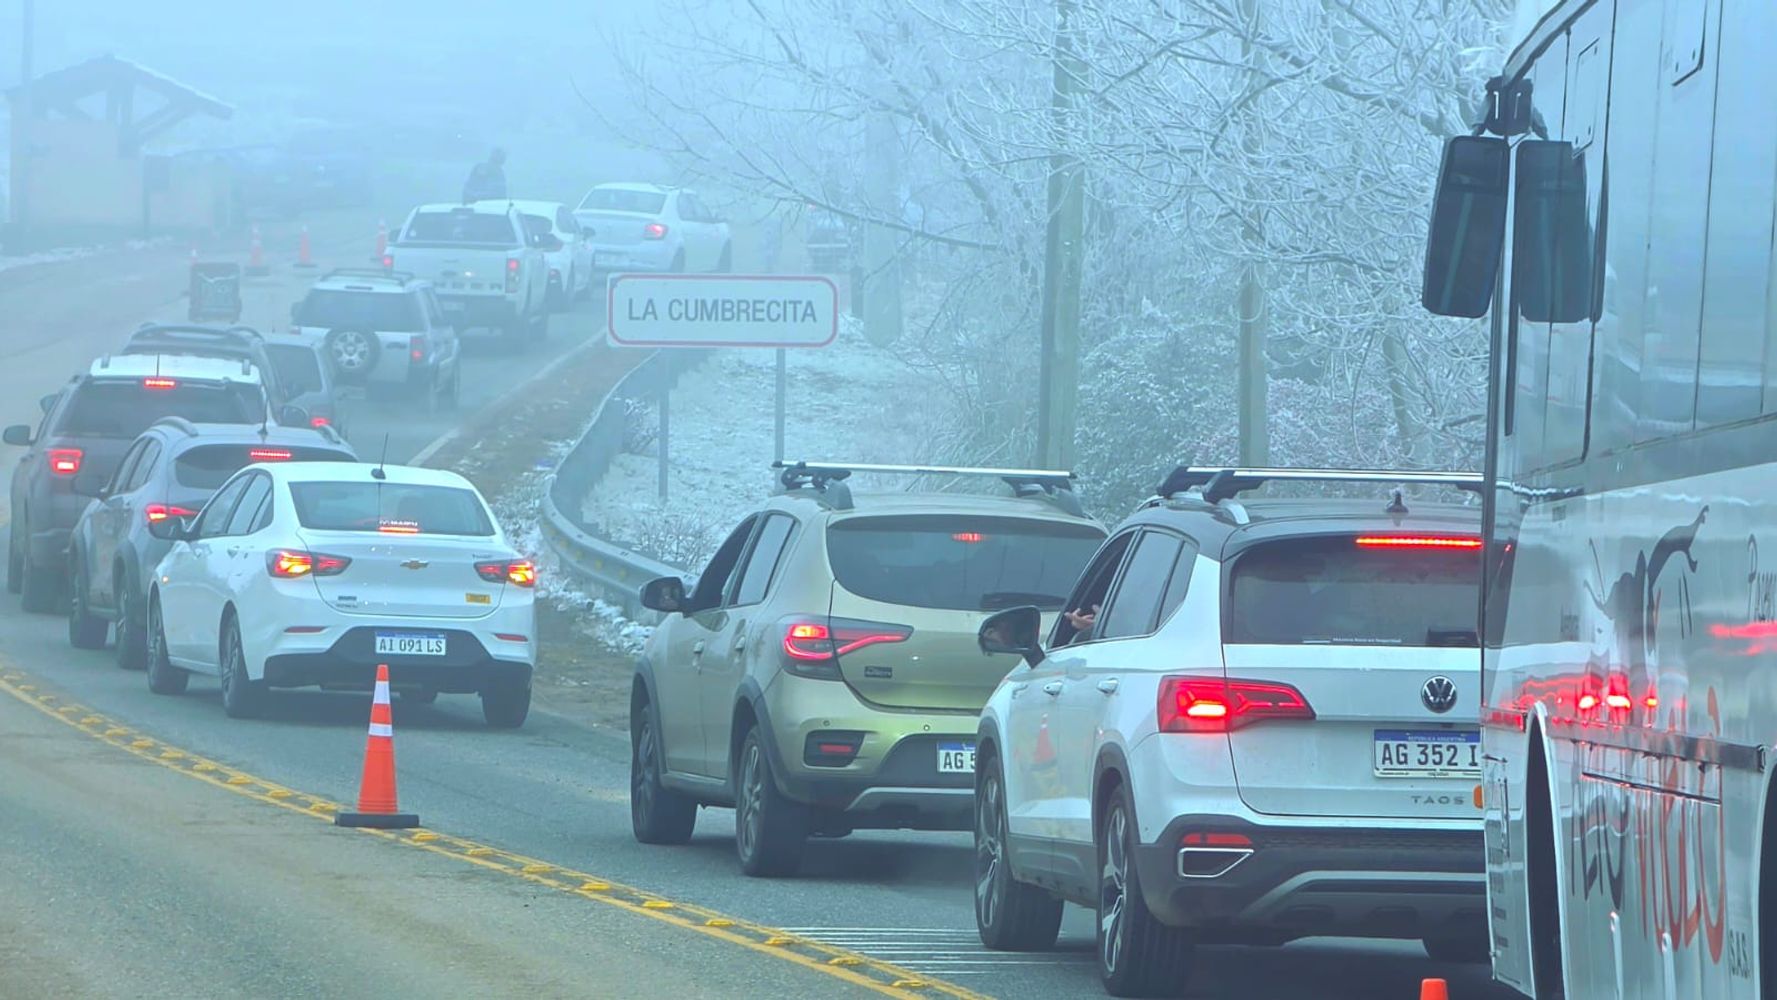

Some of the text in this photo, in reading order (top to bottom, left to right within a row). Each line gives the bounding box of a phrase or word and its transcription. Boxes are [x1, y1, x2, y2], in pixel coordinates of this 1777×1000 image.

[628, 298, 817, 323] LA CUMBRECITA
[379, 639, 443, 653] AI 091 LS
[943, 751, 964, 770] AG
[1382, 743, 1408, 766] AG
[1416, 743, 1458, 767] 352
[1410, 795, 1465, 805] TAOS
